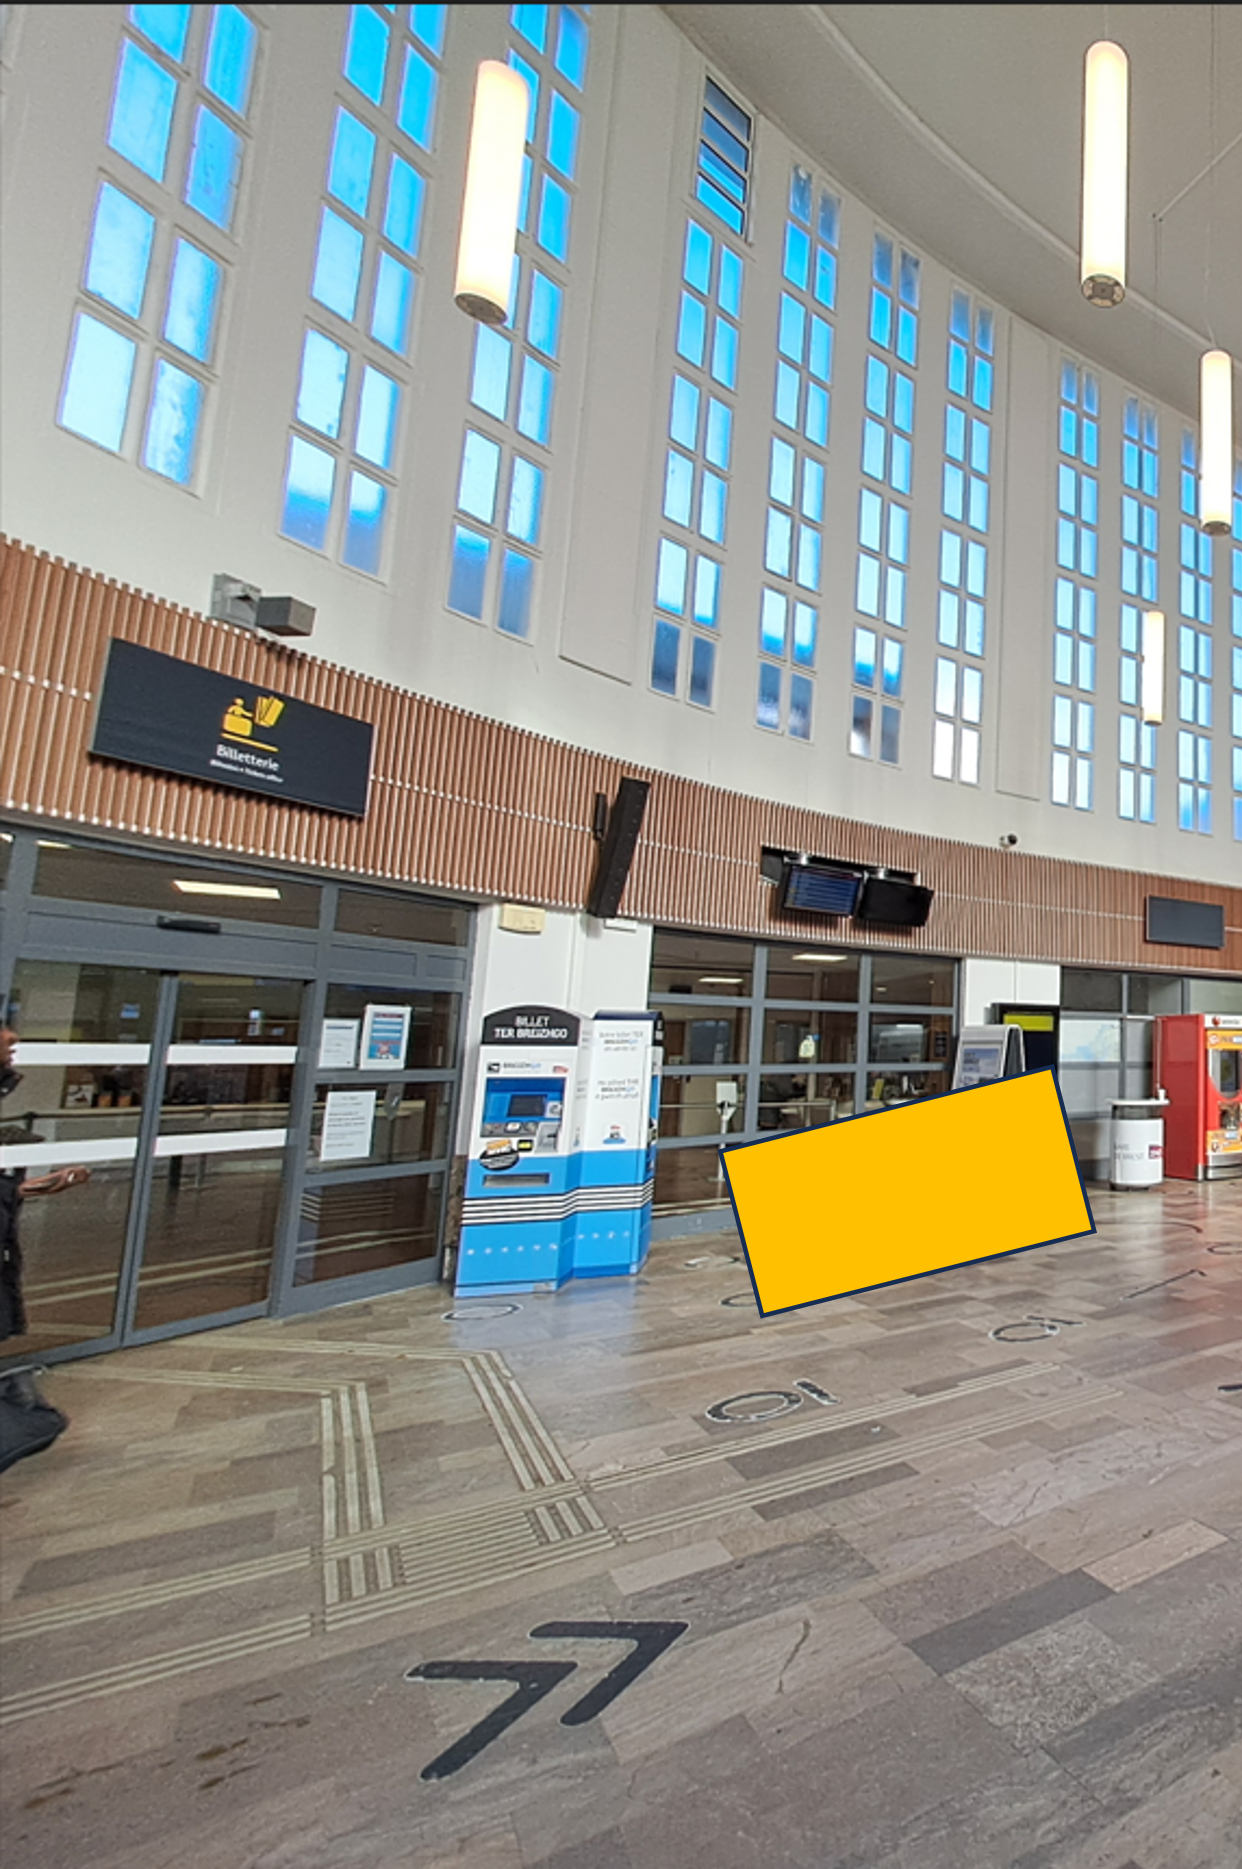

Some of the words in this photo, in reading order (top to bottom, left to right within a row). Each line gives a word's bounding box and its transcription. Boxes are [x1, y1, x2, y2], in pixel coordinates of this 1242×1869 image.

[216, 744, 279, 772] Billetterie
[514, 1015, 549, 1027] BILLET
[494, 1028, 515, 1039] TER
